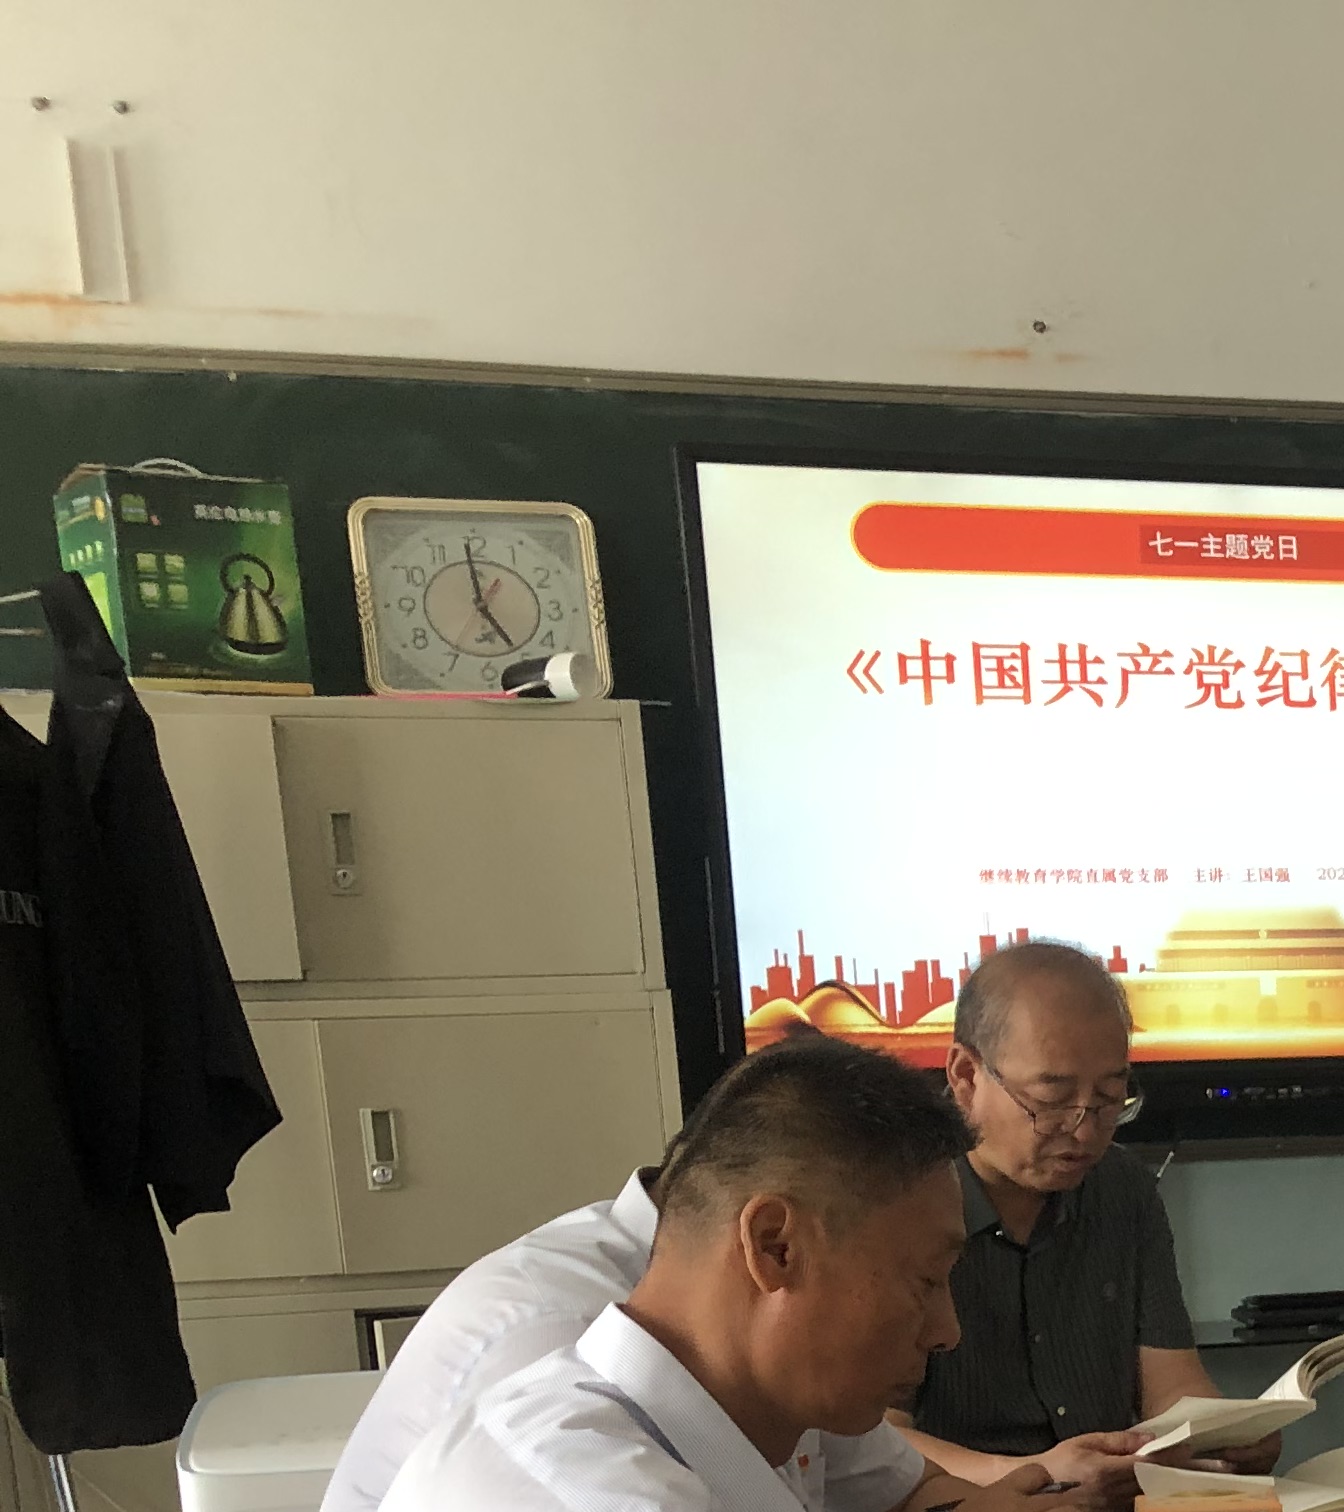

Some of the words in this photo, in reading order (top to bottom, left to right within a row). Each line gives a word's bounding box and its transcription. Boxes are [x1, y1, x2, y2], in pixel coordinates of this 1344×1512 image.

[1148, 530, 1299, 560] 七一主题党日
[534, 566, 551, 589] 2
[399, 597, 416, 617] 9
[548, 600, 563, 622] 3
[412, 627, 428, 650] 8
[978, 867, 1169, 885] 继续教育学院直属党支部
